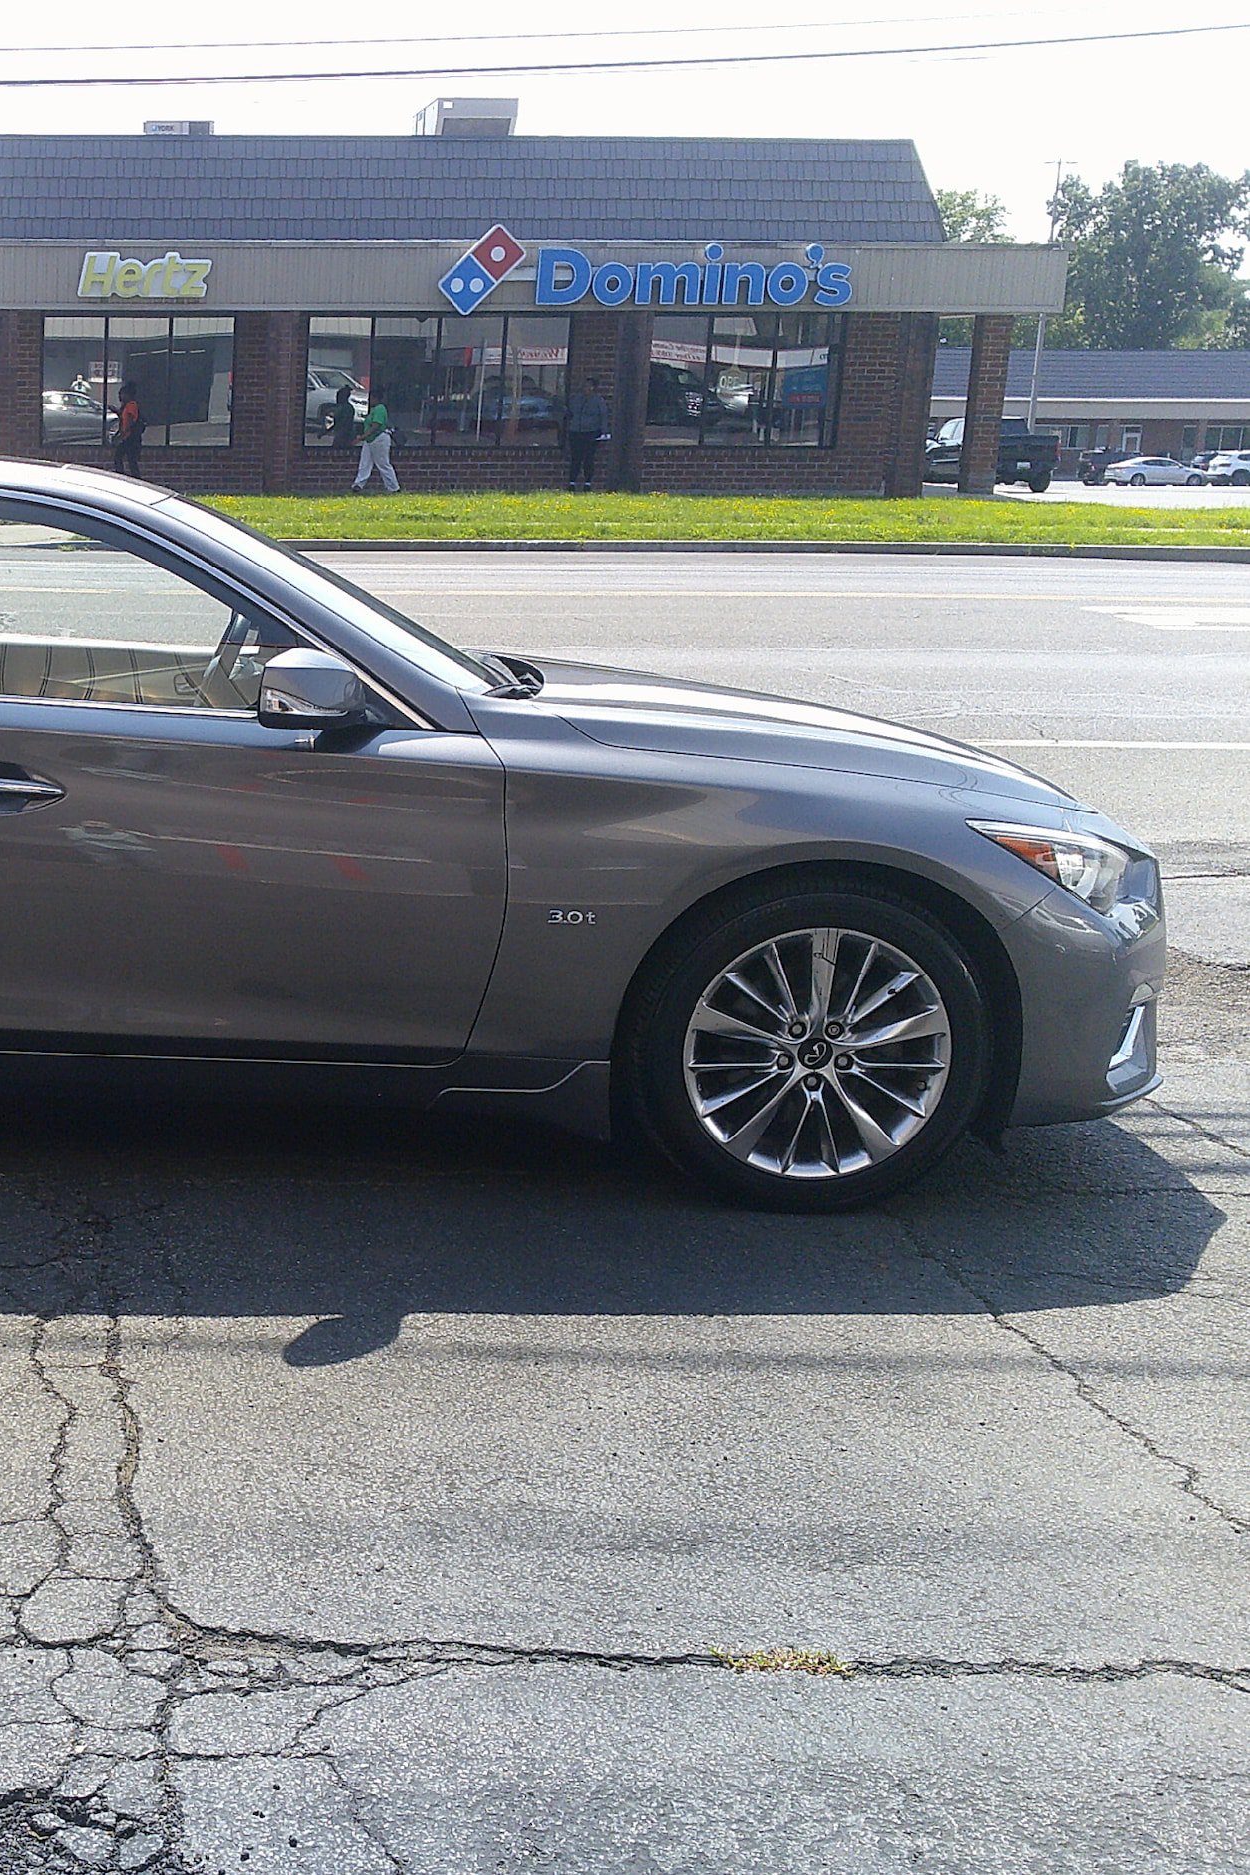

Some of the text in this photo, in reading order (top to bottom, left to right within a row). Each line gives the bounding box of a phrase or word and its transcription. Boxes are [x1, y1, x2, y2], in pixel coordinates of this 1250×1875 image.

[79, 252, 211, 297] Hertz
[536, 243, 853, 306] Domino's
[547, 909, 597, 925] 3.0t
